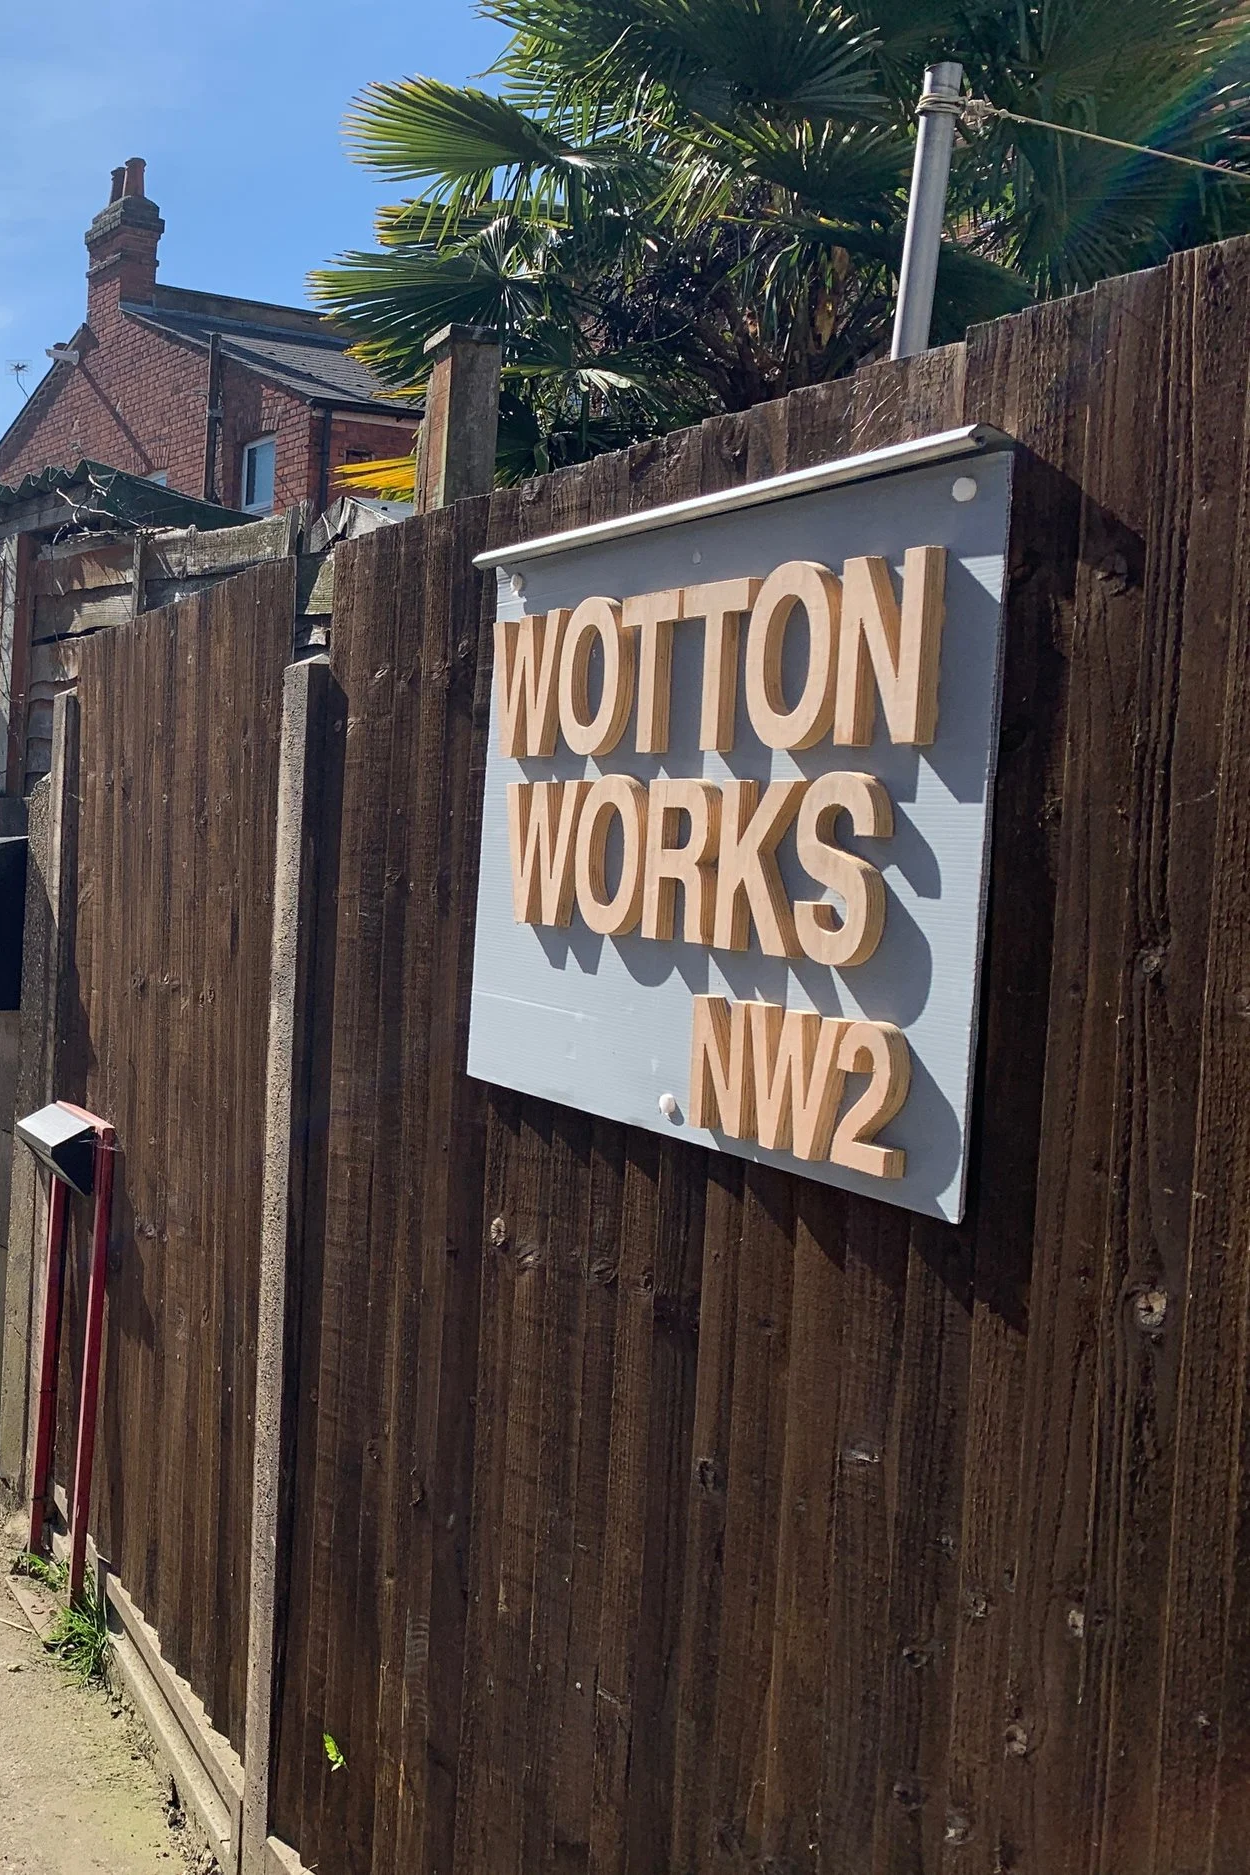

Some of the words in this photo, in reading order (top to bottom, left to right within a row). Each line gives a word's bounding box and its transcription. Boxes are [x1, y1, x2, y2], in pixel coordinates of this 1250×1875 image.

[493, 545, 947, 758] WOTTON
[506, 770, 894, 967] WORKS
[689, 994, 912, 1179] NW2
